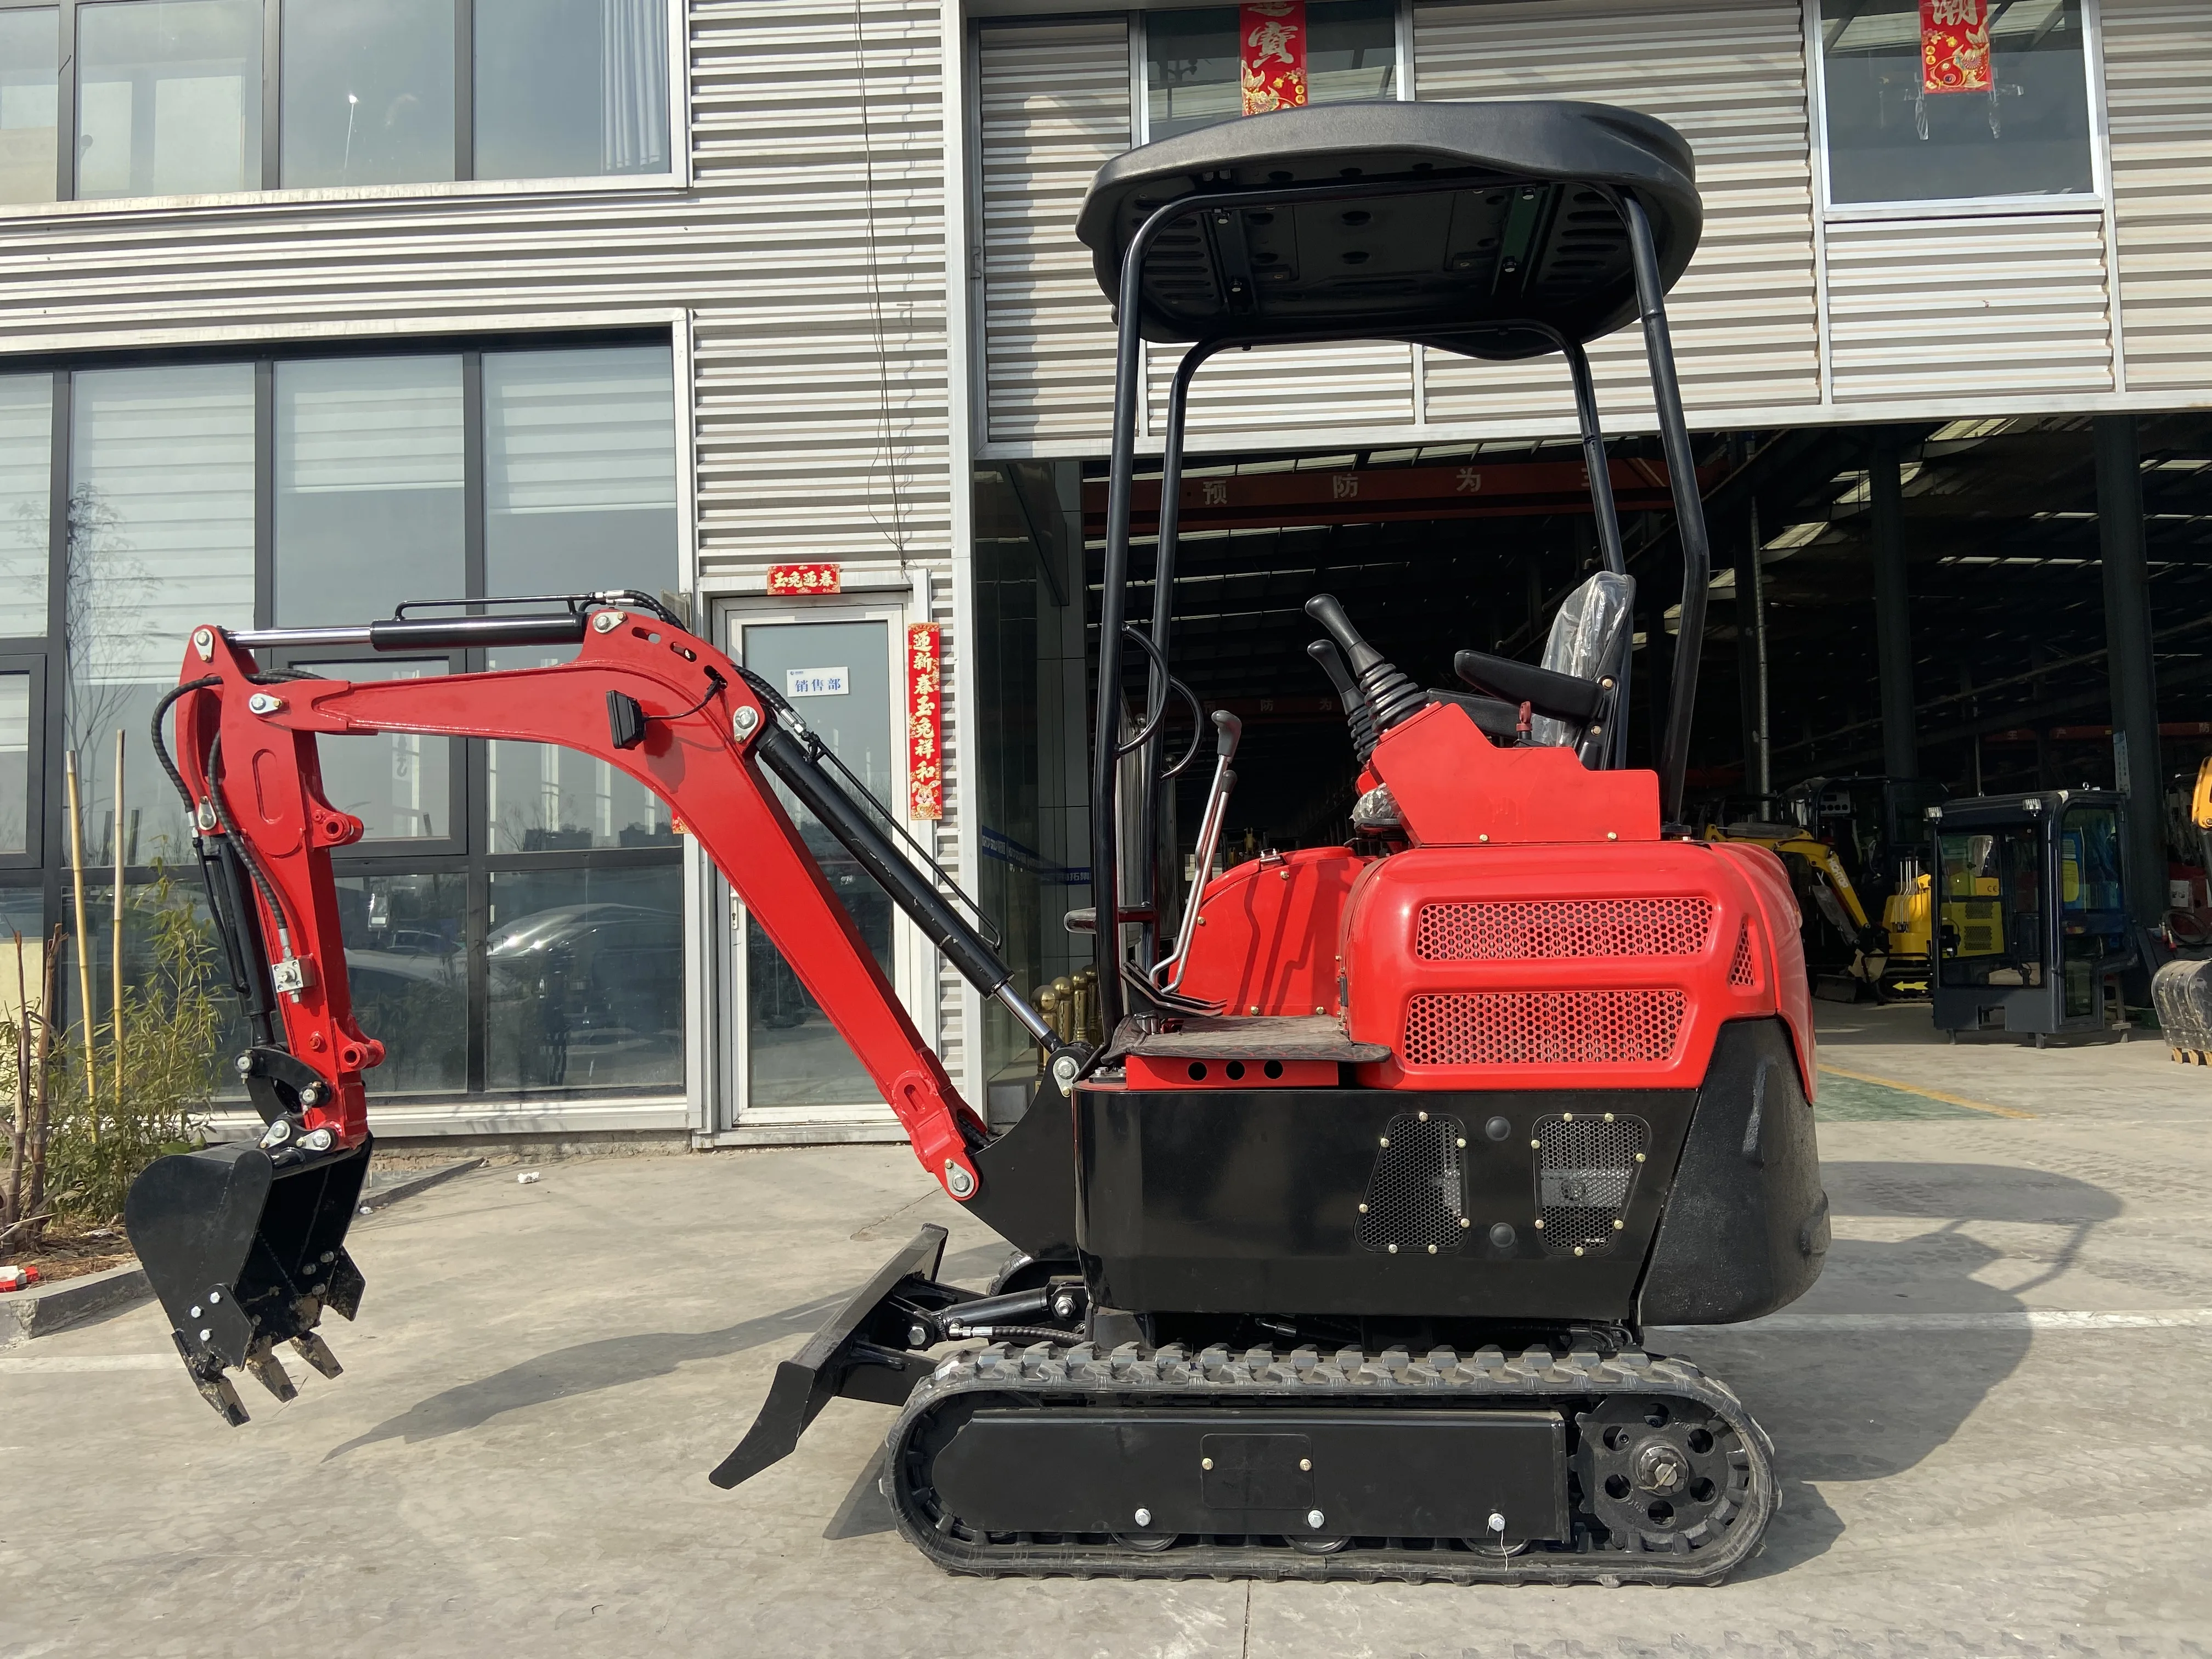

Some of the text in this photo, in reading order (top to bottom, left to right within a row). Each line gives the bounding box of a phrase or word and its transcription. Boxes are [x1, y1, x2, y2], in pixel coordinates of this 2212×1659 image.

[774, 571, 834, 588] 玉兔迎春
[795, 678, 841, 692] 销售部
[913, 630, 935, 782] 迎新春玉兔祥和
